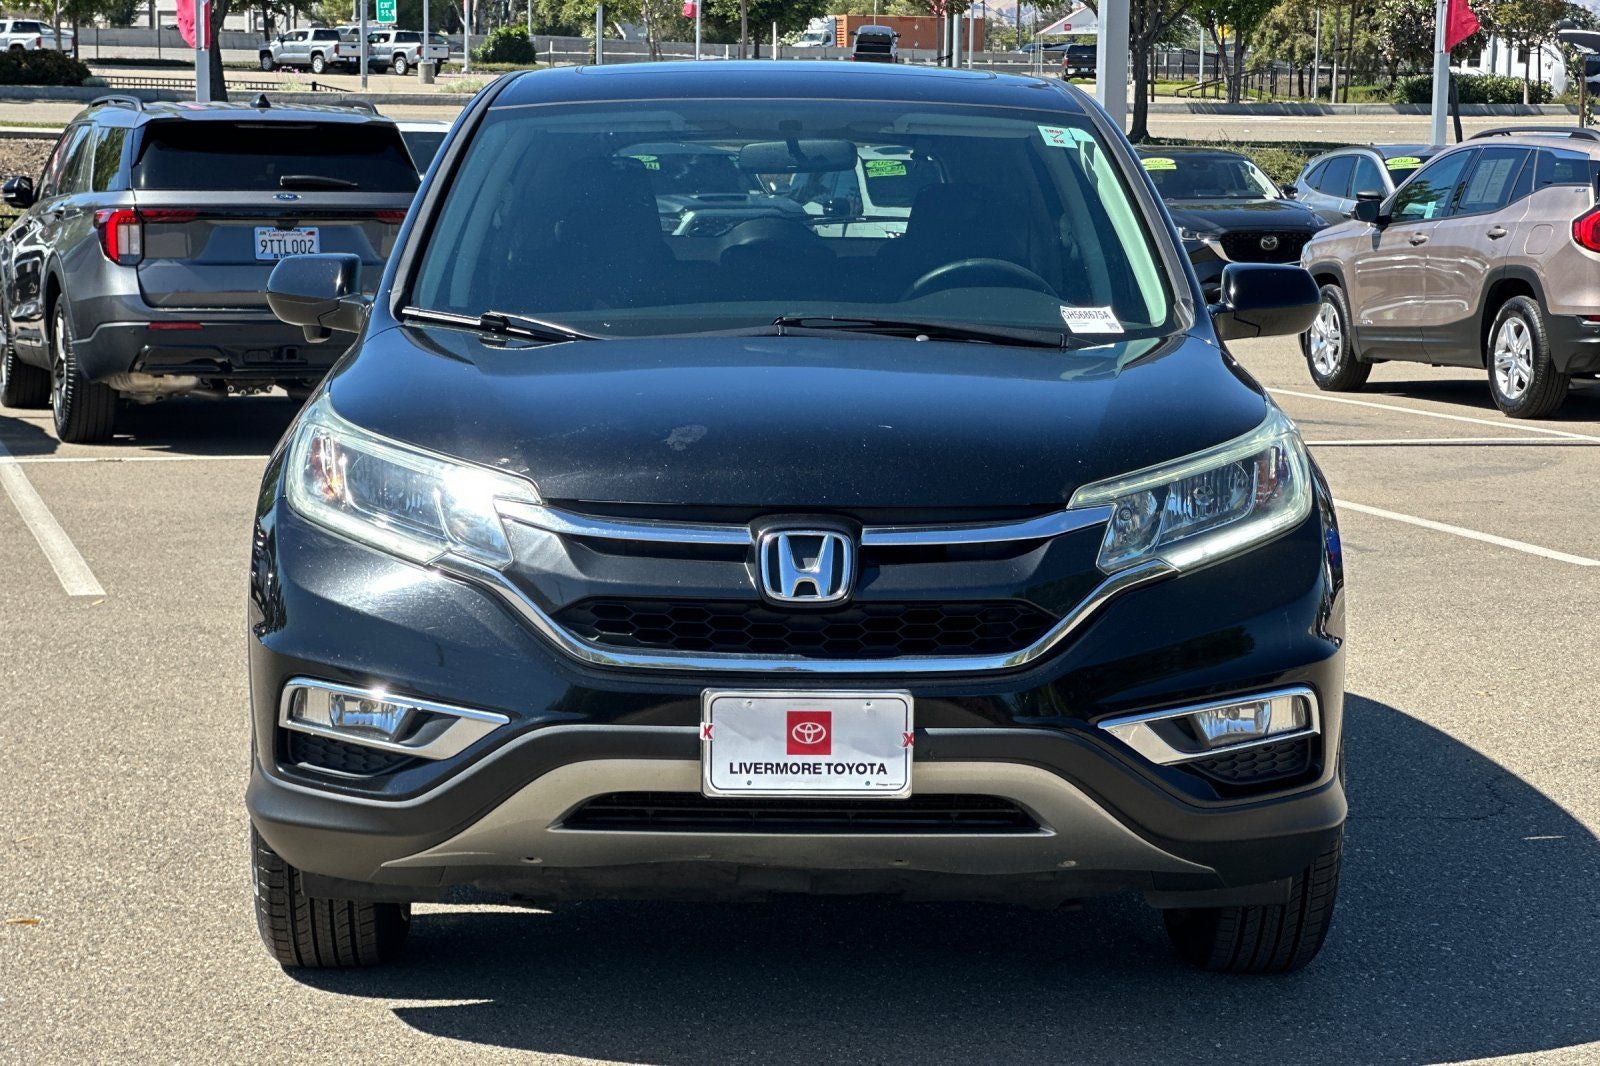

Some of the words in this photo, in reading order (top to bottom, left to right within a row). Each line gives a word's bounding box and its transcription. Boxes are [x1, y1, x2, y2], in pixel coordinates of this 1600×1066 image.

[260, 239, 315, 254] 9TTL002
[729, 762, 822, 775] LIVERMORE
[827, 762, 888, 775] TOYOTA
